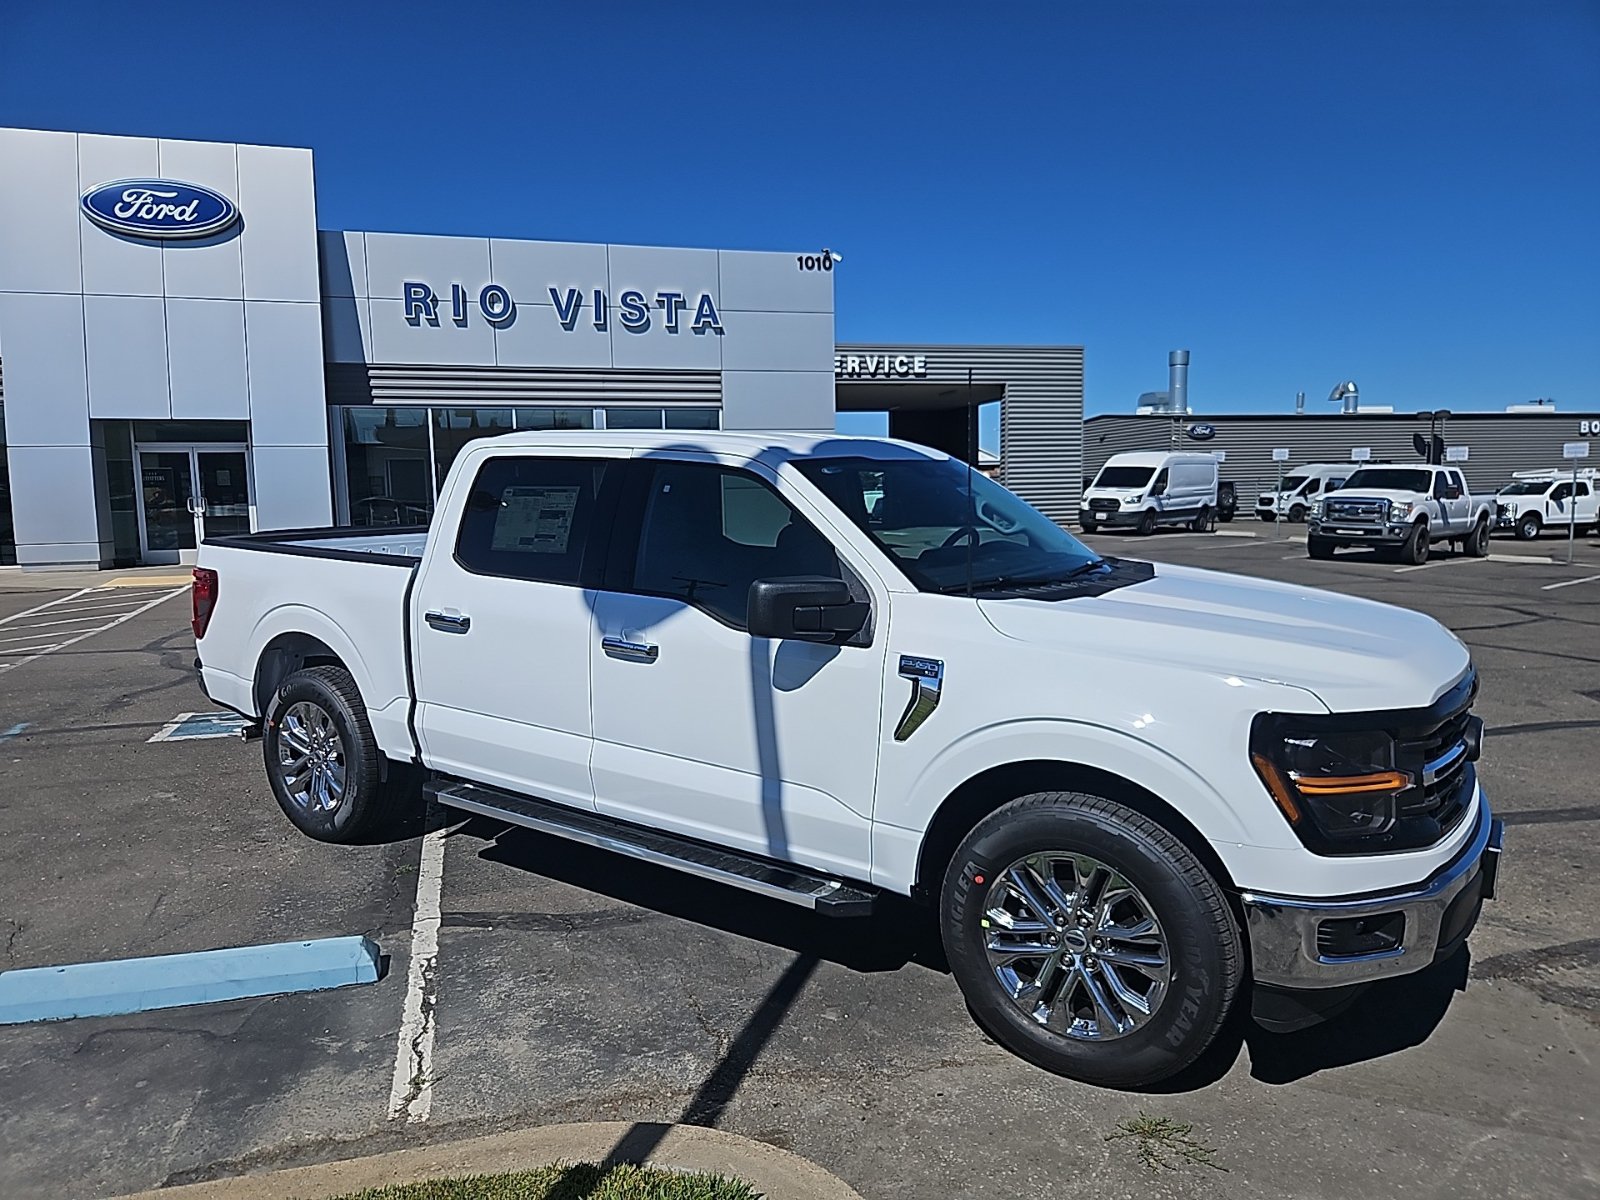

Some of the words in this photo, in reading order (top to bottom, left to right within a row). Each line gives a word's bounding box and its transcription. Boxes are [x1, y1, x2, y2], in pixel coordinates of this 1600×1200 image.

[114, 188, 199, 222] Ford
[797, 256, 832, 271] 1010
[403, 281, 512, 324] RIO
[548, 287, 722, 330] VISTA
[834, 356, 925, 373] ERVICE
